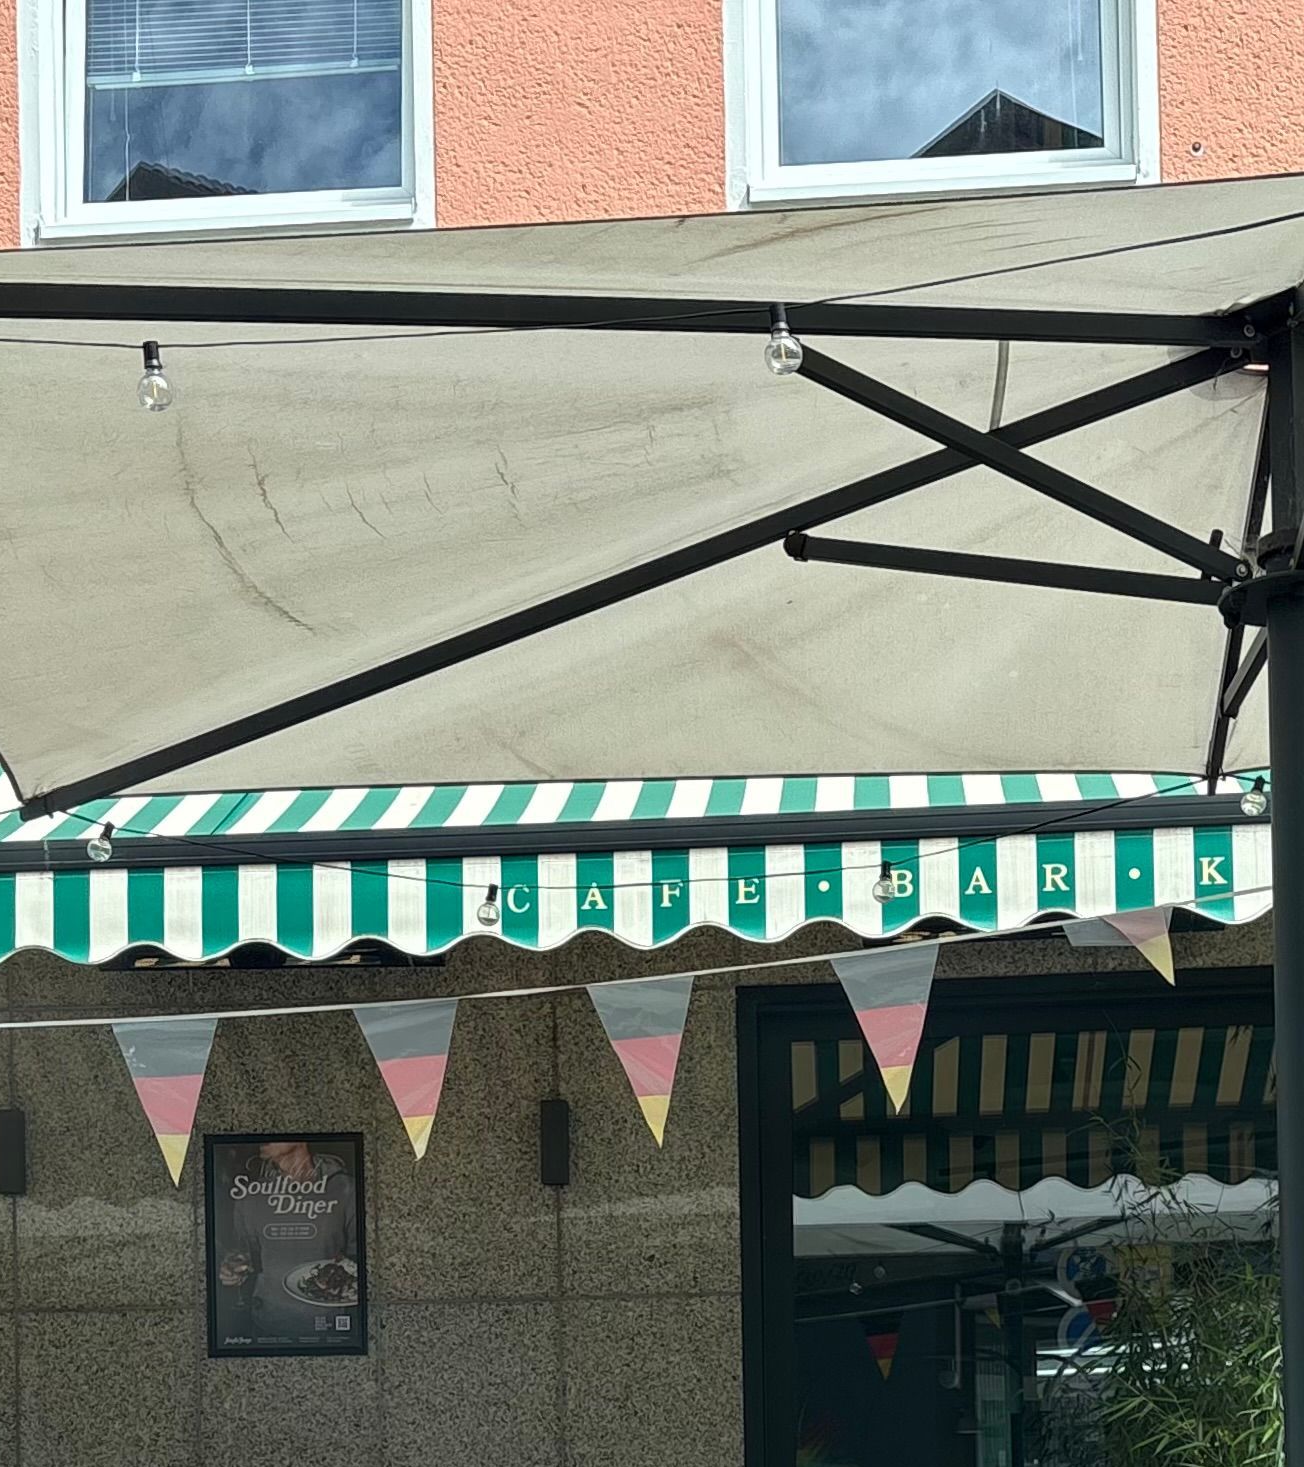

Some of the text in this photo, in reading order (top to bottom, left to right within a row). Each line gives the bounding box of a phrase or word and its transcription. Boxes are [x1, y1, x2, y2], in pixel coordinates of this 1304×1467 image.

[506, 877, 761, 913] CAFE
[888, 863, 1071, 898] BAR
[230, 1175, 328, 1199] Soulfood
[268, 1195, 338, 1219] Diner
